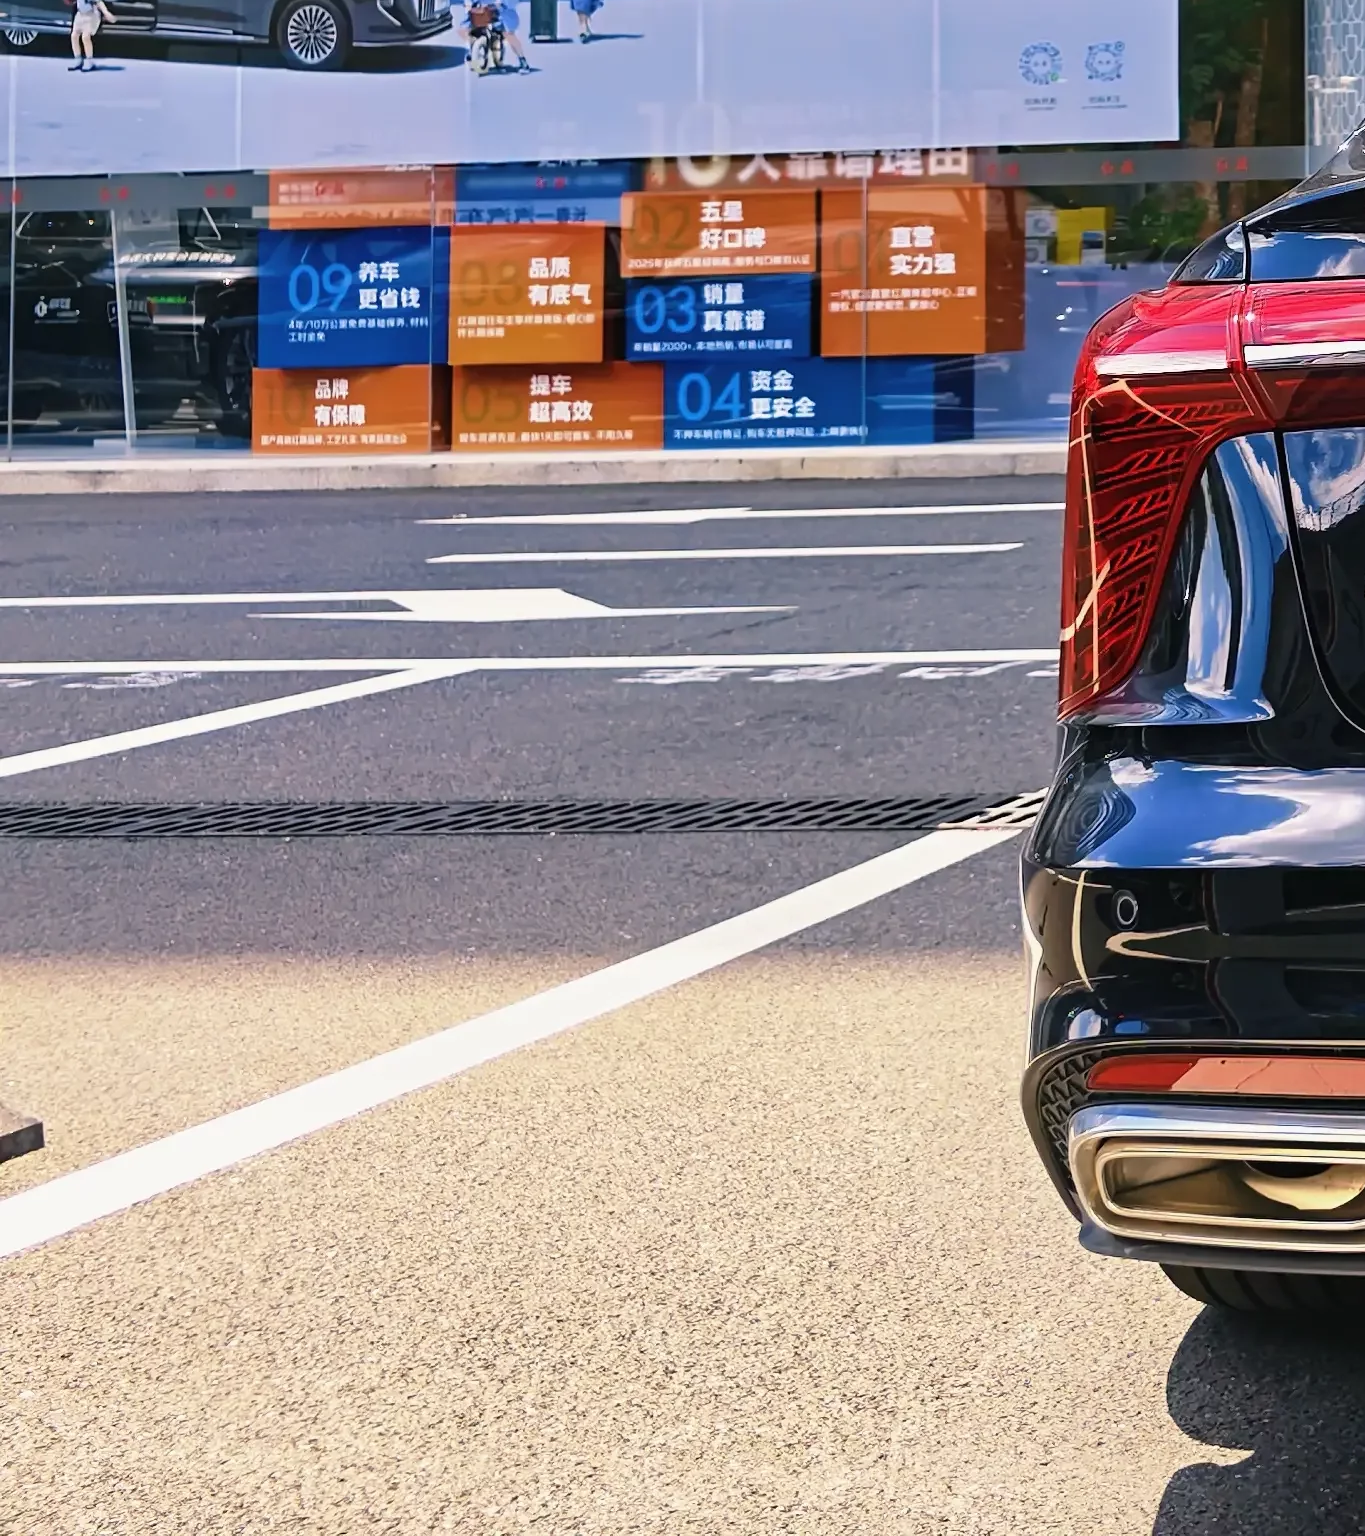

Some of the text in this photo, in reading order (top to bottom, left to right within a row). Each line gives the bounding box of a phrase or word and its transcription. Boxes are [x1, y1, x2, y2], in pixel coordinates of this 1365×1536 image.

[700, 200, 744, 222] 五星
[700, 227, 767, 249] 好口碑
[889, 226, 935, 248] 直营
[359, 262, 400, 282] 养车
[528, 257, 571, 279] 品质
[889, 253, 956, 275] 实力强
[288, 263, 352, 312] 09
[358, 287, 421, 310] 更省钱
[528, 284, 593, 306] 有底气
[703, 283, 745, 304] 销量
[635, 285, 697, 334] 03
[703, 310, 766, 332] 真靠谱
[315, 379, 349, 400] 品牌
[530, 374, 573, 396] 提车
[751, 370, 794, 392] 资金
[677, 372, 745, 421] 04
[750, 396, 816, 419] 更安全
[315, 404, 365, 426] 有保障
[529, 400, 594, 423] 超高效
